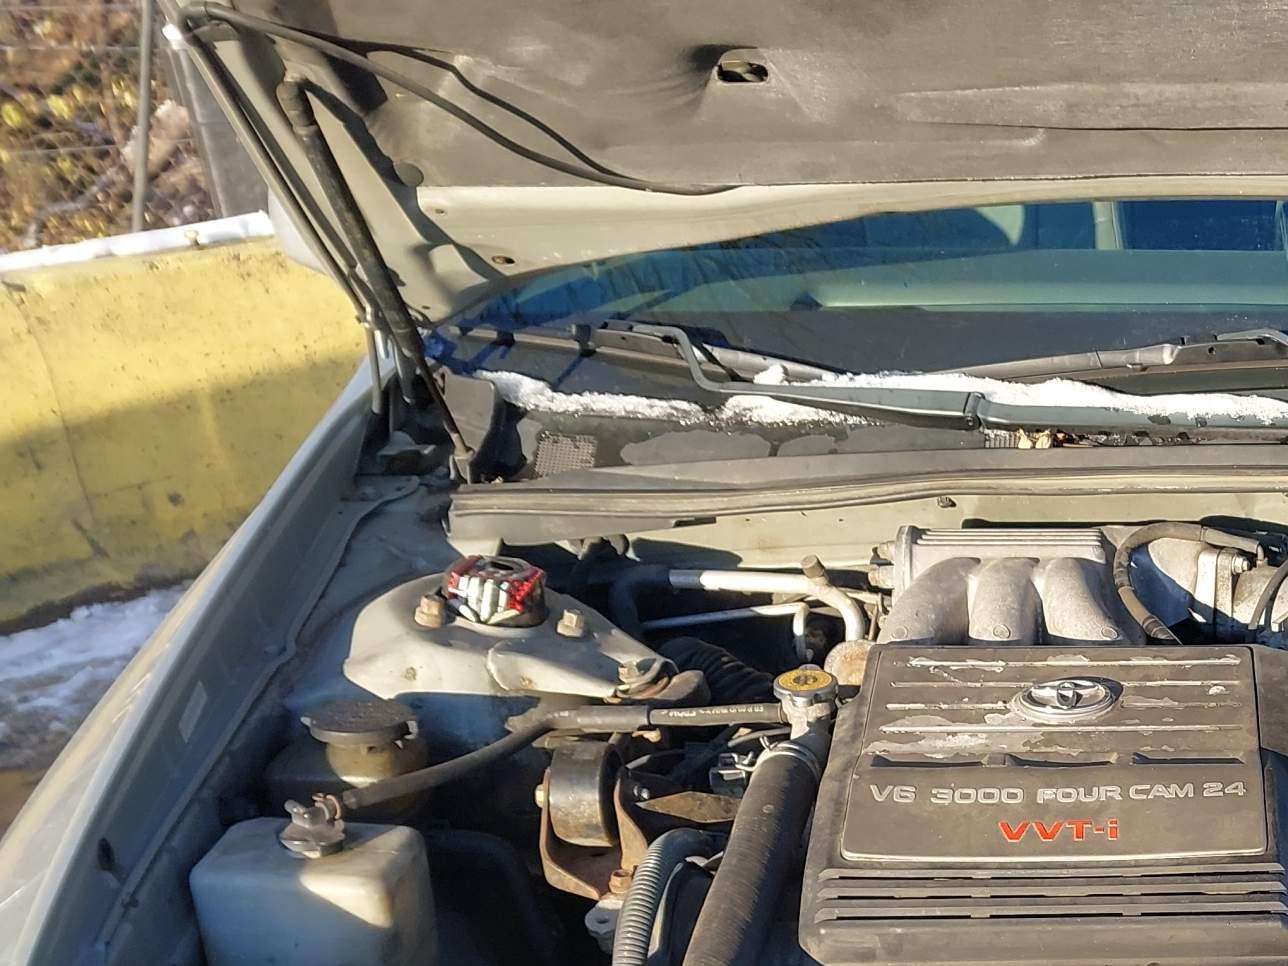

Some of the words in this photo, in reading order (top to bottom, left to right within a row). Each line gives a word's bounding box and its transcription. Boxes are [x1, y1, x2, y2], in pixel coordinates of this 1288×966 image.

[869, 784, 917, 803] V6
[930, 786, 1024, 805] 3000
[1036, 784, 1123, 804] FOUR
[1129, 782, 1195, 800] CAM
[1202, 781, 1247, 798] 24
[997, 817, 1121, 843] VVT-i
